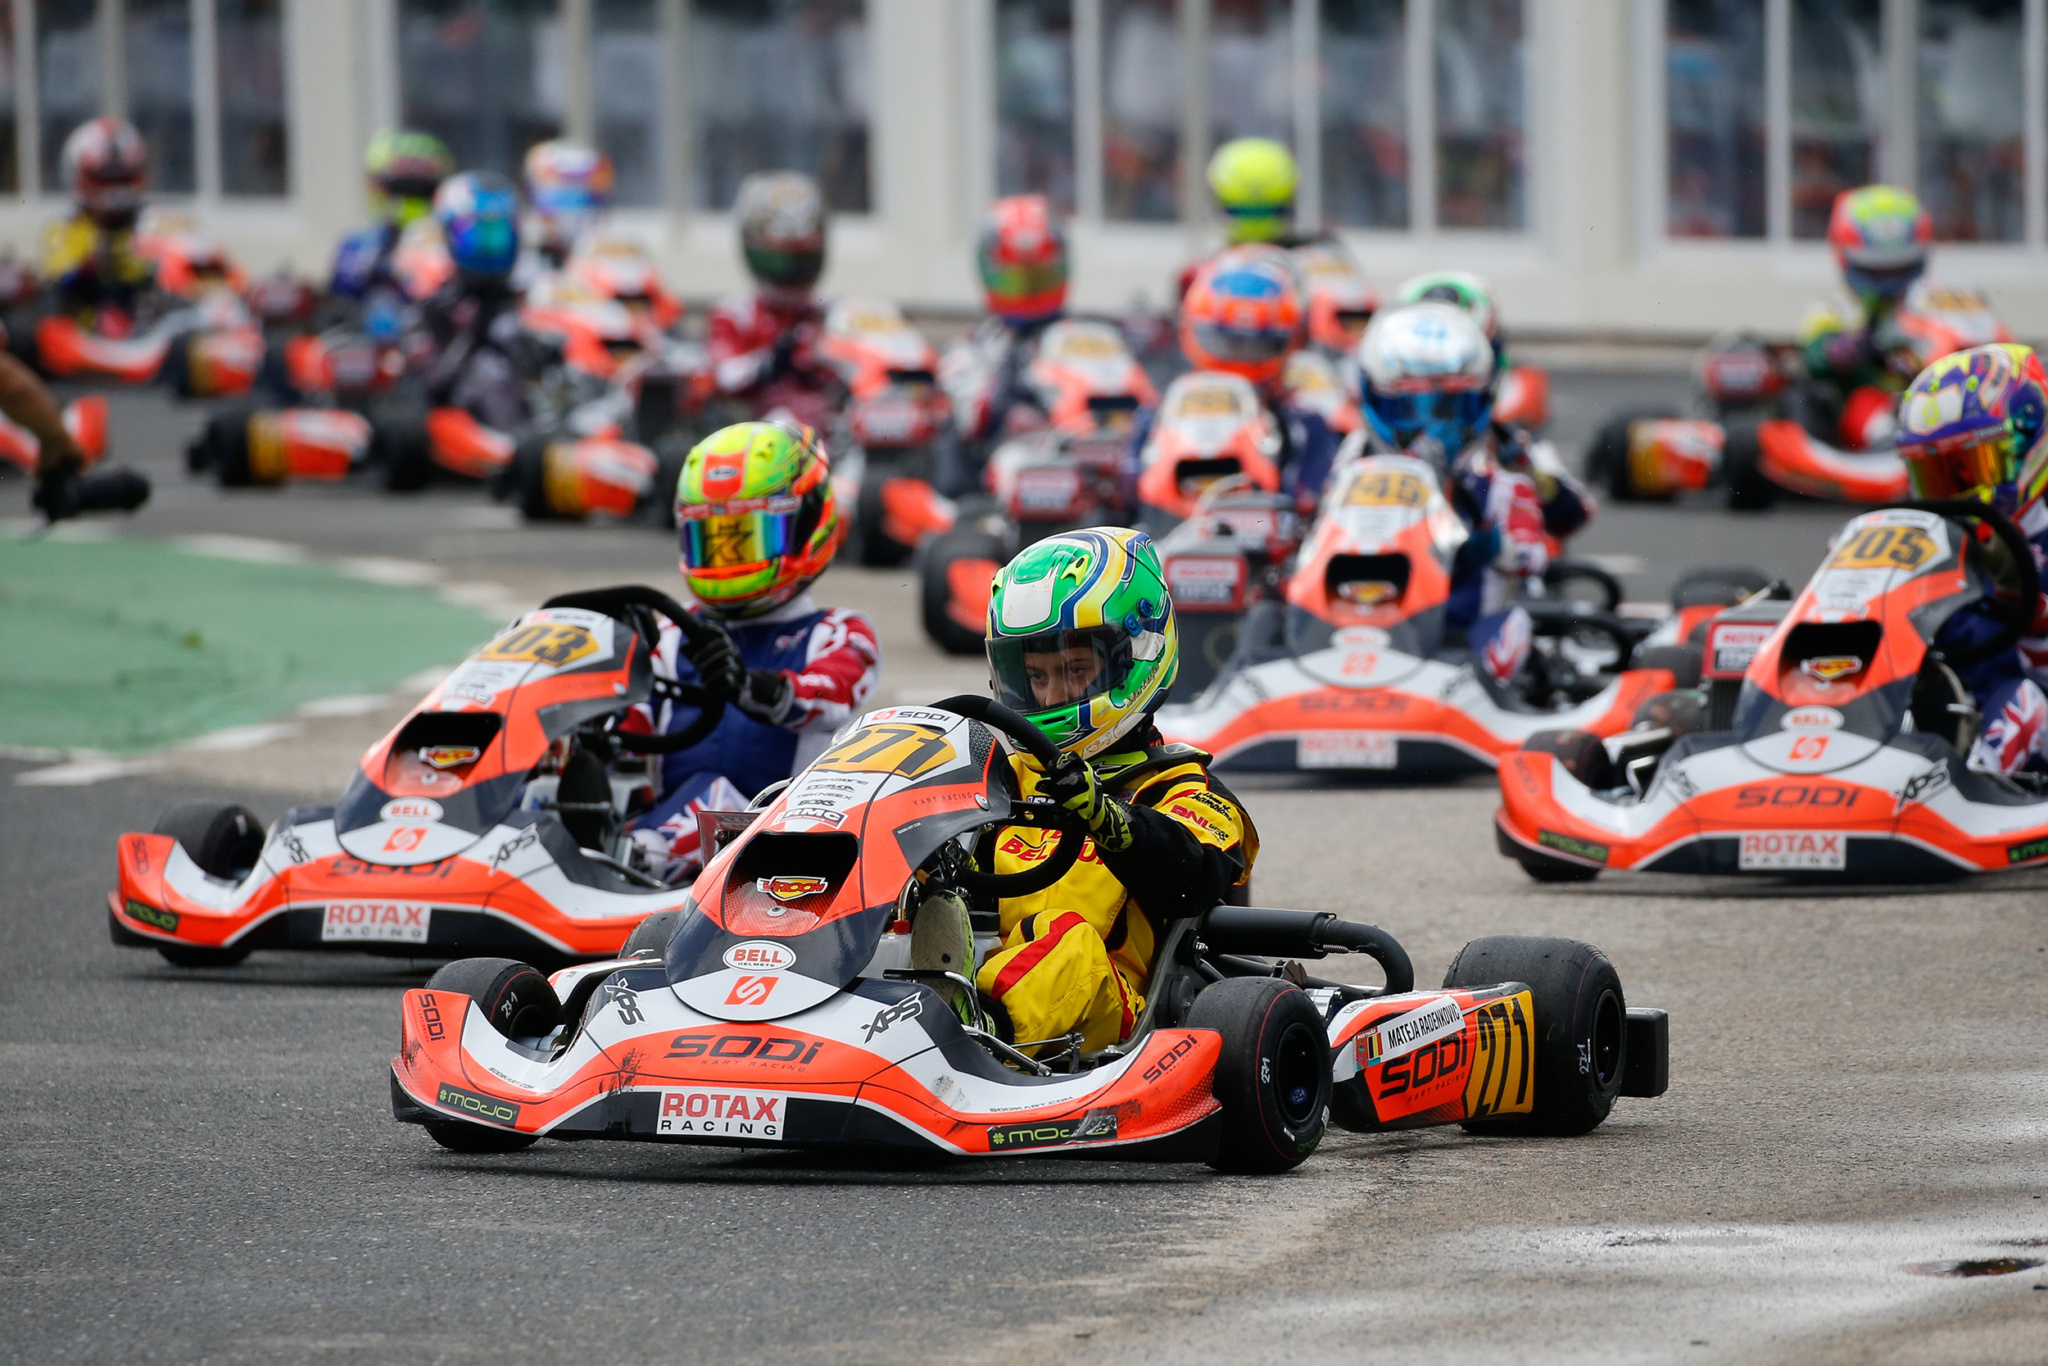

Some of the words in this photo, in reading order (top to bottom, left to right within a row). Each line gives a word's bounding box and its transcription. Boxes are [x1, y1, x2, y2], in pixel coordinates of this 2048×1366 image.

[1833, 530, 1923, 565] 05
[816, 727, 949, 776] 271
[913, 796, 938, 806] KART
[941, 792, 973, 802] RACING
[785, 808, 842, 822] RMC
[1743, 832, 1840, 854] ROTAX
[326, 903, 425, 926] ROTAX
[733, 949, 783, 963] BELL
[1388, 1019, 1420, 1049] MATEJA
[1419, 1002, 1461, 1038] RADENKOVIC
[701, 1058, 741, 1066] KART
[749, 1061, 806, 1072] RACING
[1469, 997, 1529, 1118] 271
[1435, 1071, 1466, 1090] RACING
[661, 1093, 779, 1122] ROTAX
[660, 1119, 777, 1137] RACING
